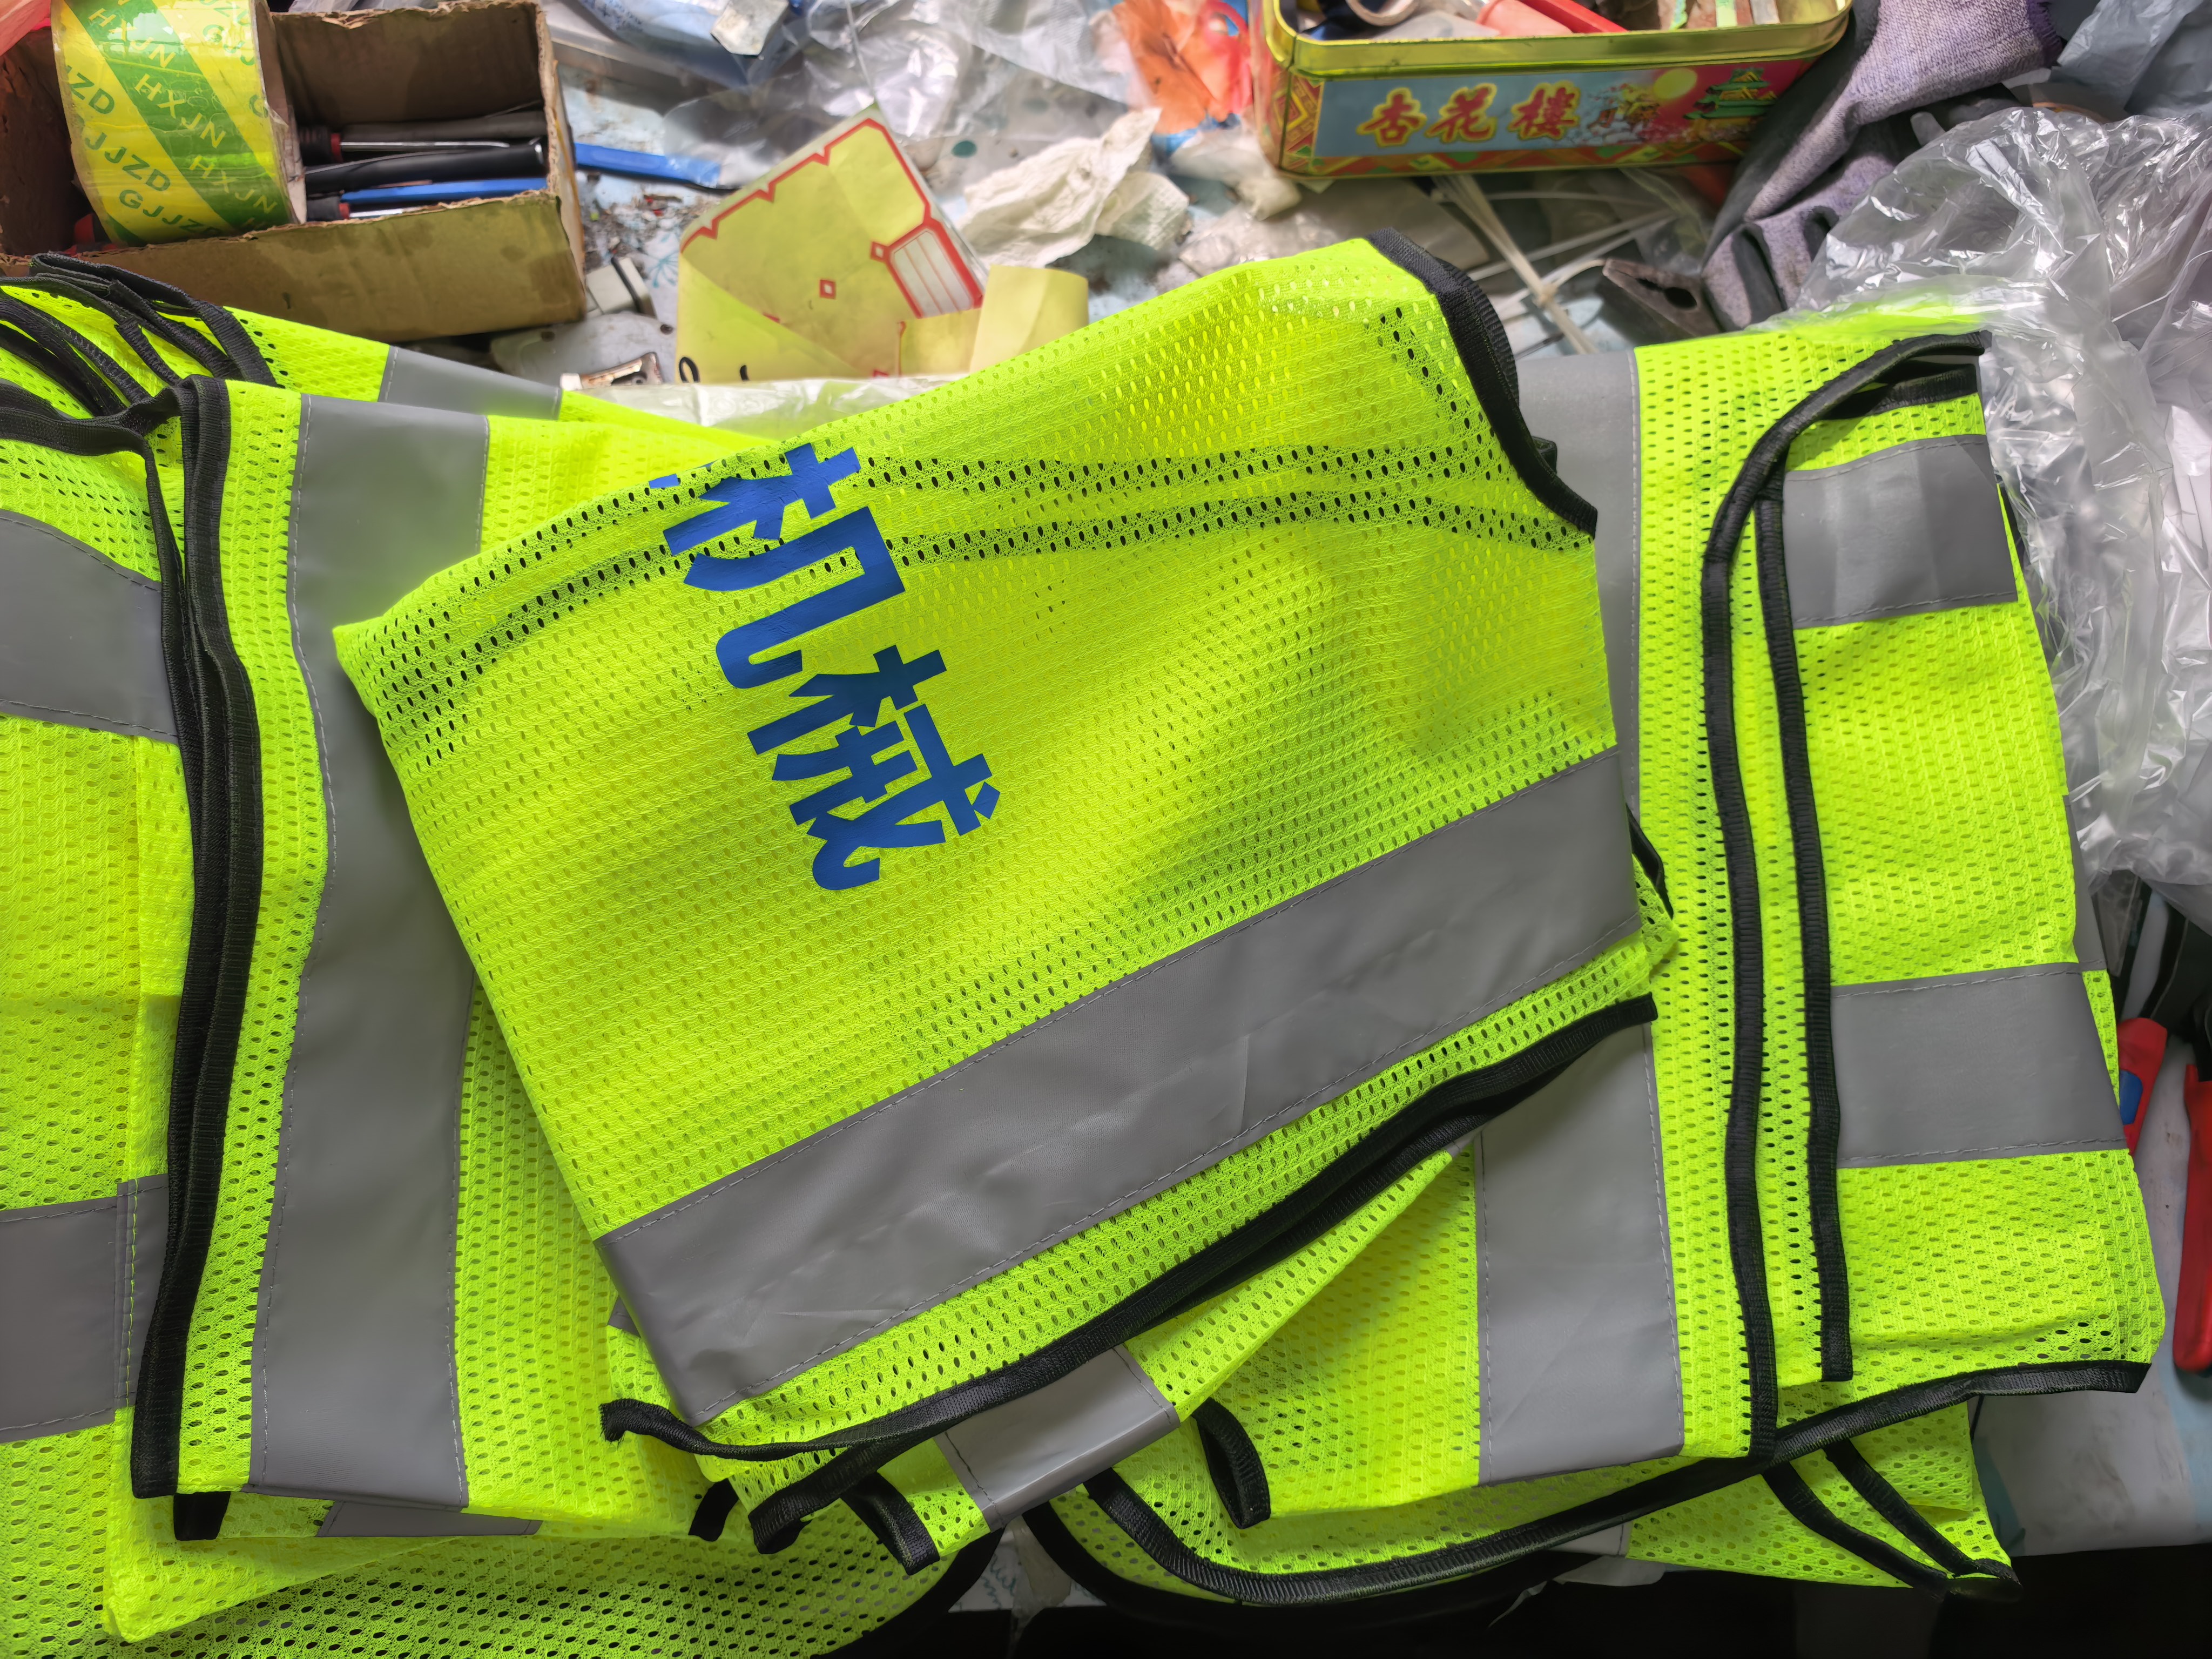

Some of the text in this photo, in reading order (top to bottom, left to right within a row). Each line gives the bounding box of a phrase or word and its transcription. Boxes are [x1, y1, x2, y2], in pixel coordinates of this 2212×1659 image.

[88, 8, 177, 68] HXJN
[66, 65, 115, 114] ZD
[134, 73, 227, 149] HXJN
[190, 154, 278, 214] HXJN
[649, 443, 1001, 891] 机械
